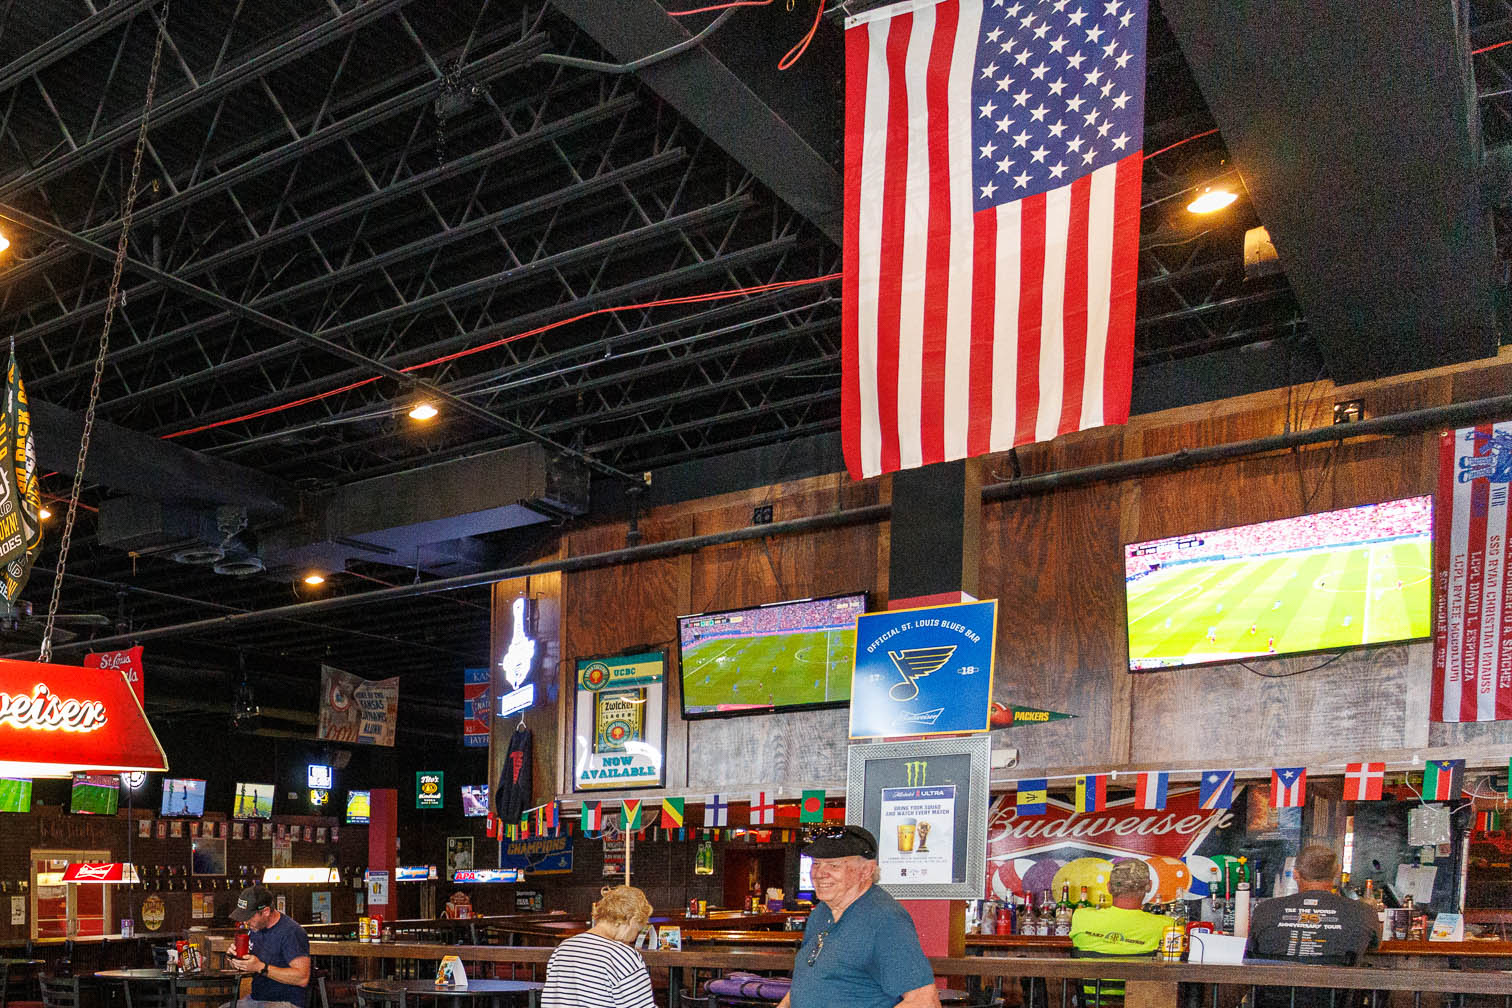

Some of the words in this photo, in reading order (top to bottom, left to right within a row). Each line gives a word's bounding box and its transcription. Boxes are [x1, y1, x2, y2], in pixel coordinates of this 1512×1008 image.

[1487, 560, 1499, 587] RYAN
[1451, 584, 1463, 619] RYLEE
[1468, 583, 1480, 614] DAVID
[1482, 592, 1497, 649] CHRISTIAN
[867, 627, 900, 653] OFFICIAL
[901, 623, 914, 632] ST.
[915, 619, 939, 628] LOUIS
[941, 620, 965, 633] BLUES
[964, 629, 981, 643] BAR
[1464, 629, 1477, 682] ESPINOZA
[1014, 711, 1049, 722] PACKERS
[581, 766, 655, 780] AVAILABLE
[602, 756, 633, 767] NOW
[988, 806, 1234, 843] Budweiser
[507, 837, 567, 856] CHAMPIONS
[454, 872, 475, 880] APA
